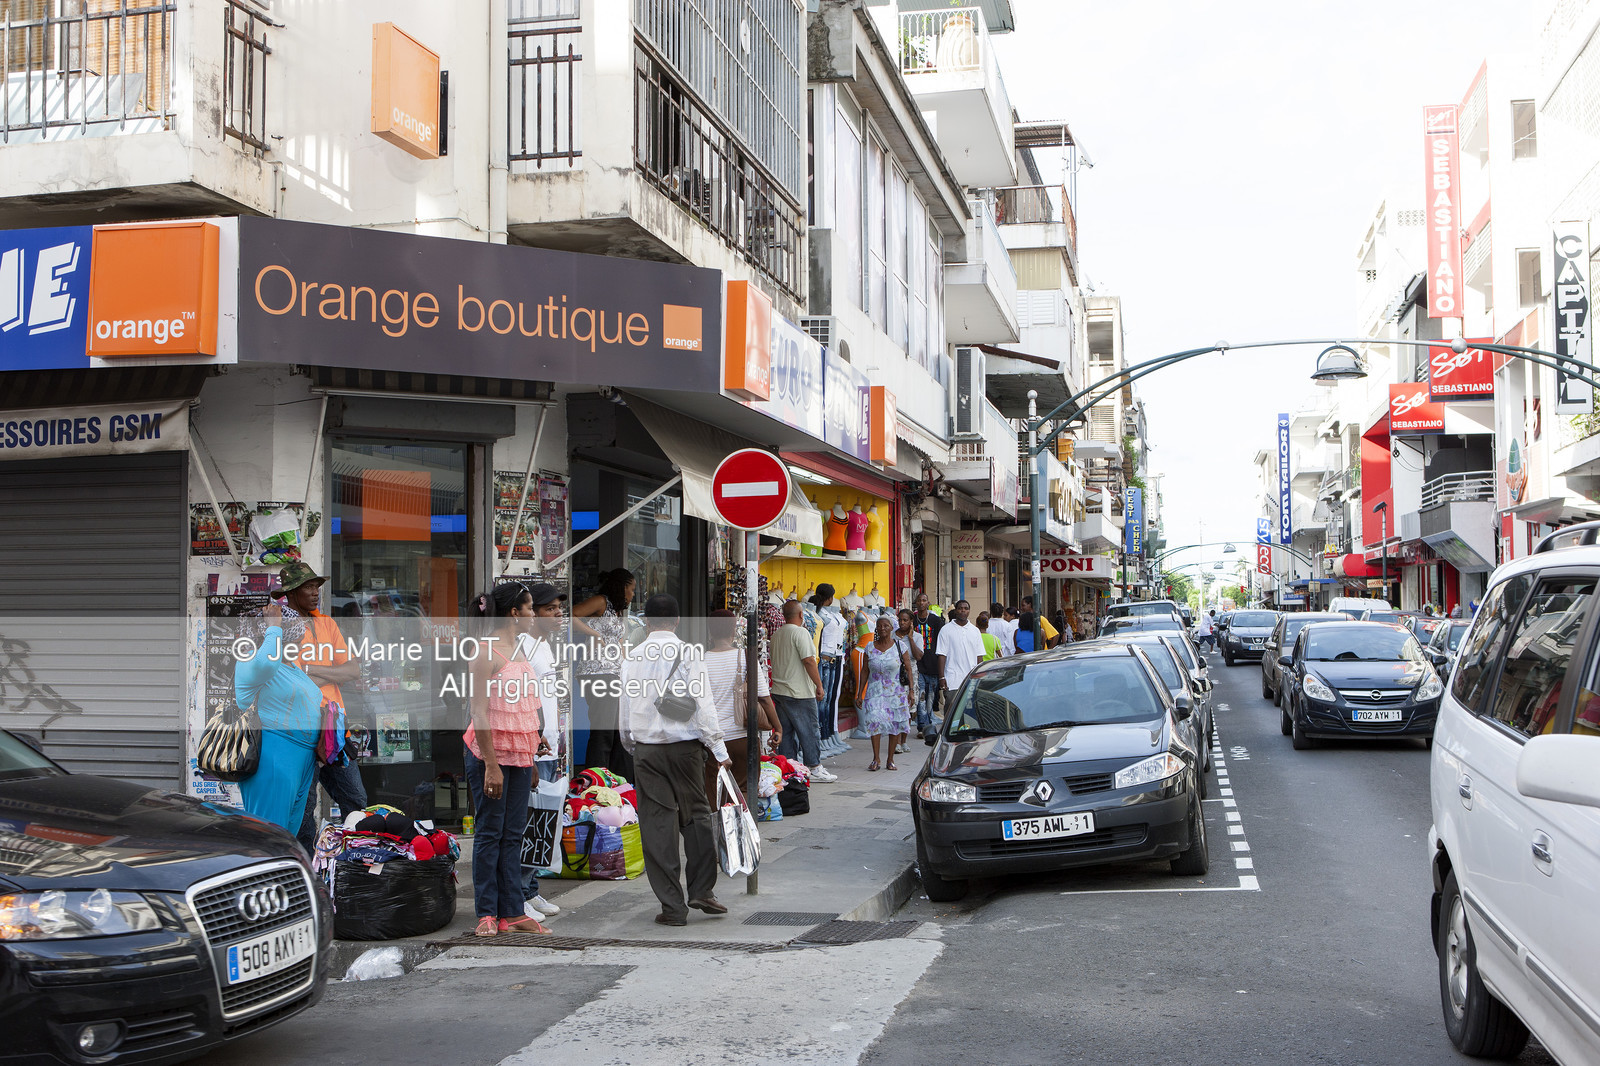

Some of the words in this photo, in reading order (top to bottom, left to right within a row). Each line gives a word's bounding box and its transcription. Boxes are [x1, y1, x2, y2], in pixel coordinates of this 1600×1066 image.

[393, 107, 432, 142] orange
[1432, 138, 1455, 313] SEBASTIANO
[254, 264, 440, 338] Orange
[457, 284, 650, 353] boutique
[96, 315, 185, 344] orange
[665, 338, 698, 350] orange
[1432, 383, 1494, 394] SEBASTIANO
[108, 412, 162, 443] GSM
[1392, 420, 1443, 428] SEBASTIANO
[1280, 428, 1290, 491] TAILOR
[1282, 492, 1290, 541] TOM
[1132, 525, 1141, 552] CHER
[1358, 712, 1372, 720] 702
[1374, 712, 1389, 720] AYW
[522, 810, 556, 838] ACK
[1013, 820, 1040, 836] 375
[1044, 818, 1070, 833] AWL
[520, 838, 552, 866] PPER
[242, 940, 270, 973] 508
[274, 930, 296, 963] AXY
